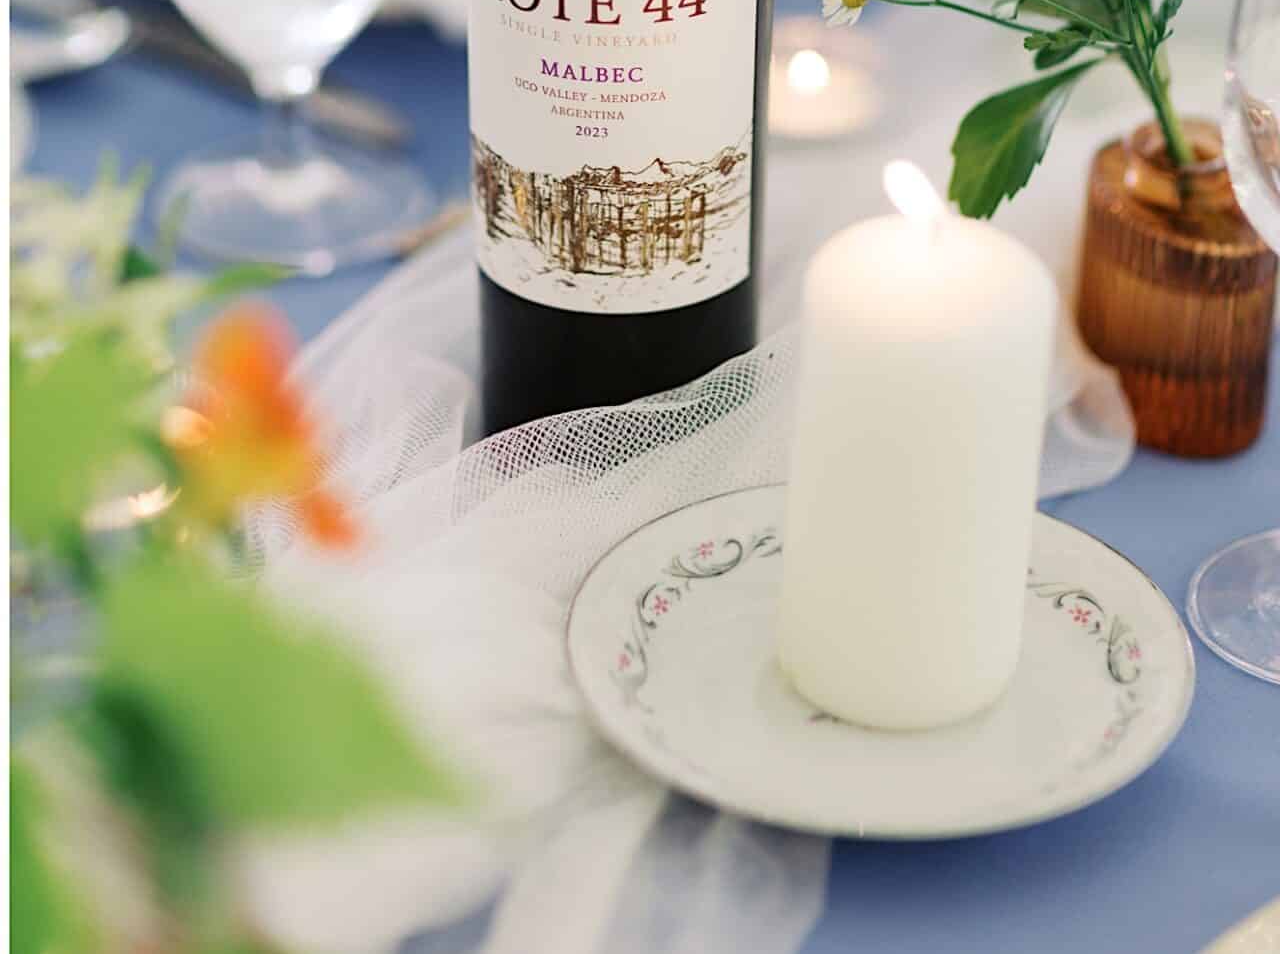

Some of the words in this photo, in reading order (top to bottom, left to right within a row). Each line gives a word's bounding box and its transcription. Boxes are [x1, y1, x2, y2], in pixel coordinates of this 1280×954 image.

[499, 13, 561, 43] SINGLE
[572, 32, 678, 48] VINEYARD
[540, 58, 645, 84] MALBEC
[514, 77, 539, 93] UCO
[541, 85, 588, 103] VALLEY
[600, 91, 667, 104] MENDOZA
[550, 104, 625, 121] ARGENTINA
[574, 125, 610, 139] 2023
